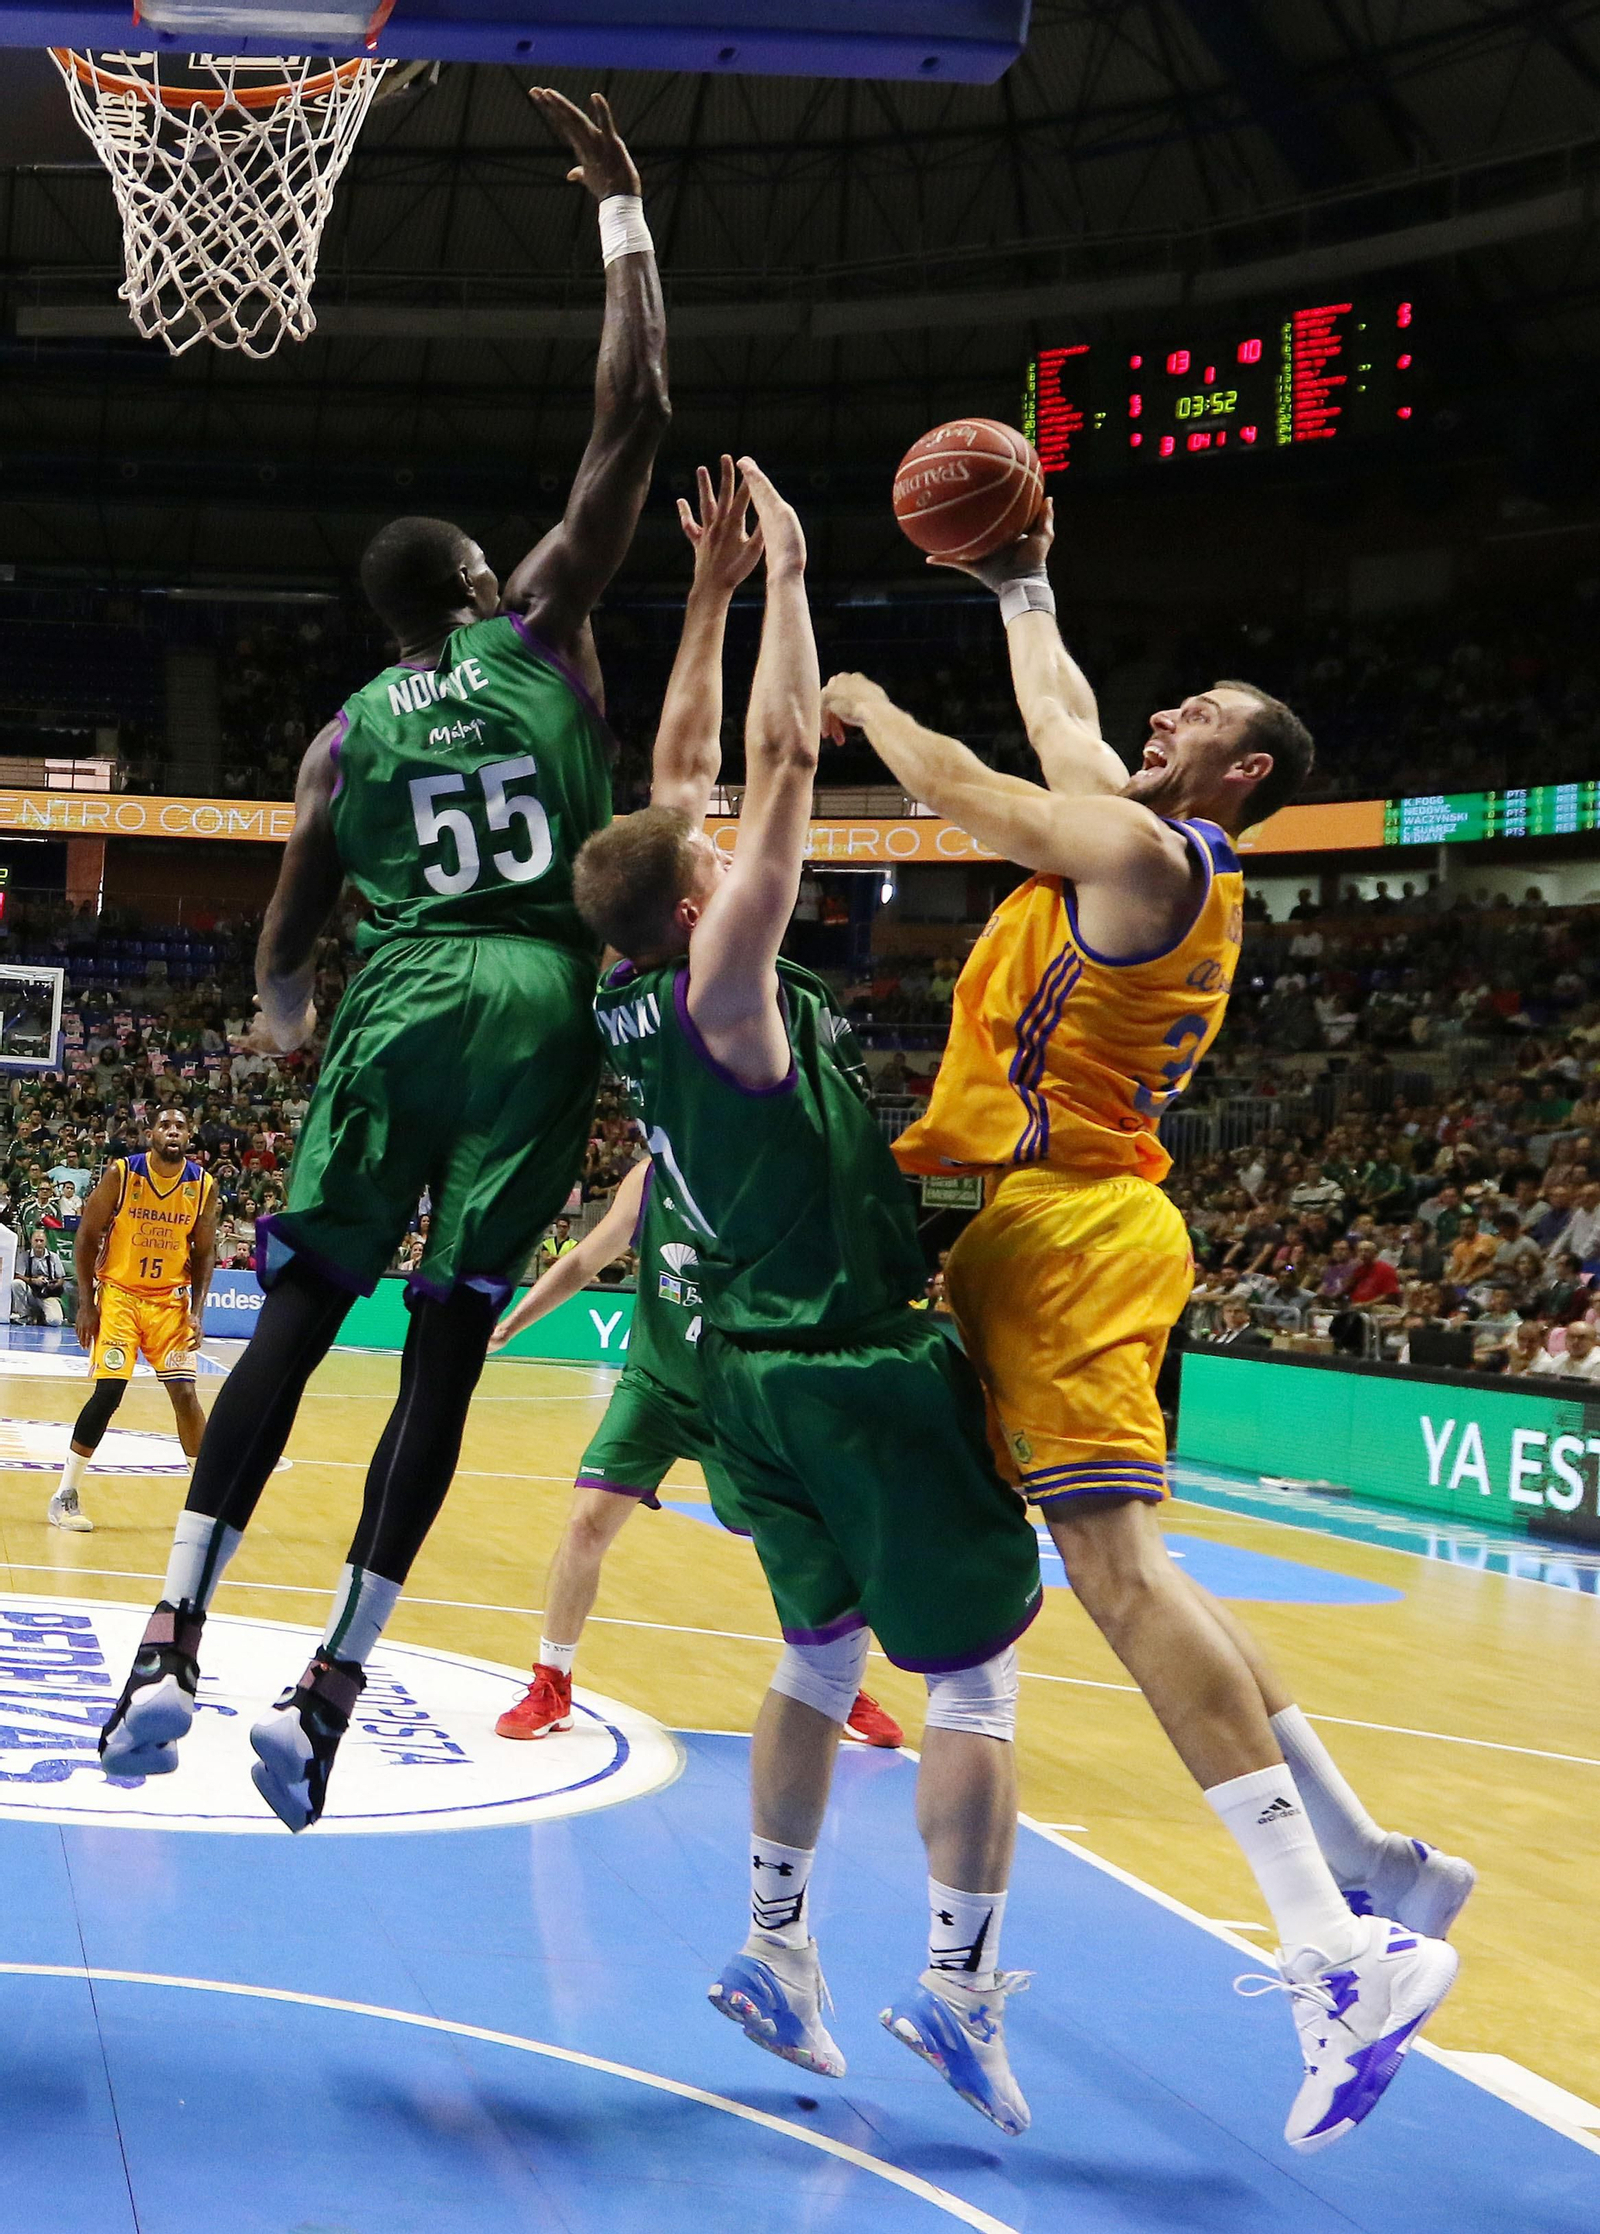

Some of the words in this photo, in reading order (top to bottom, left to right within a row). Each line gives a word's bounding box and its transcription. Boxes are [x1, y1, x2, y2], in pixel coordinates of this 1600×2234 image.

[1167, 350, 1190, 374] 13
[1238, 339, 1262, 363] 10
[1175, 390, 1238, 419] 03:52
[160, 804, 297, 837] COME
[409, 755, 553, 895] 55
[129, 1207, 192, 1226] HERBALIFE
[141, 1222, 173, 1238] Gran
[140, 1257, 163, 1279] 15
[204, 1287, 267, 1310] ndes
[1420, 1415, 1491, 1496] YA
[356, 1665, 475, 1766] UTOPISTA
[1258, 1806, 1302, 1825] adidas
